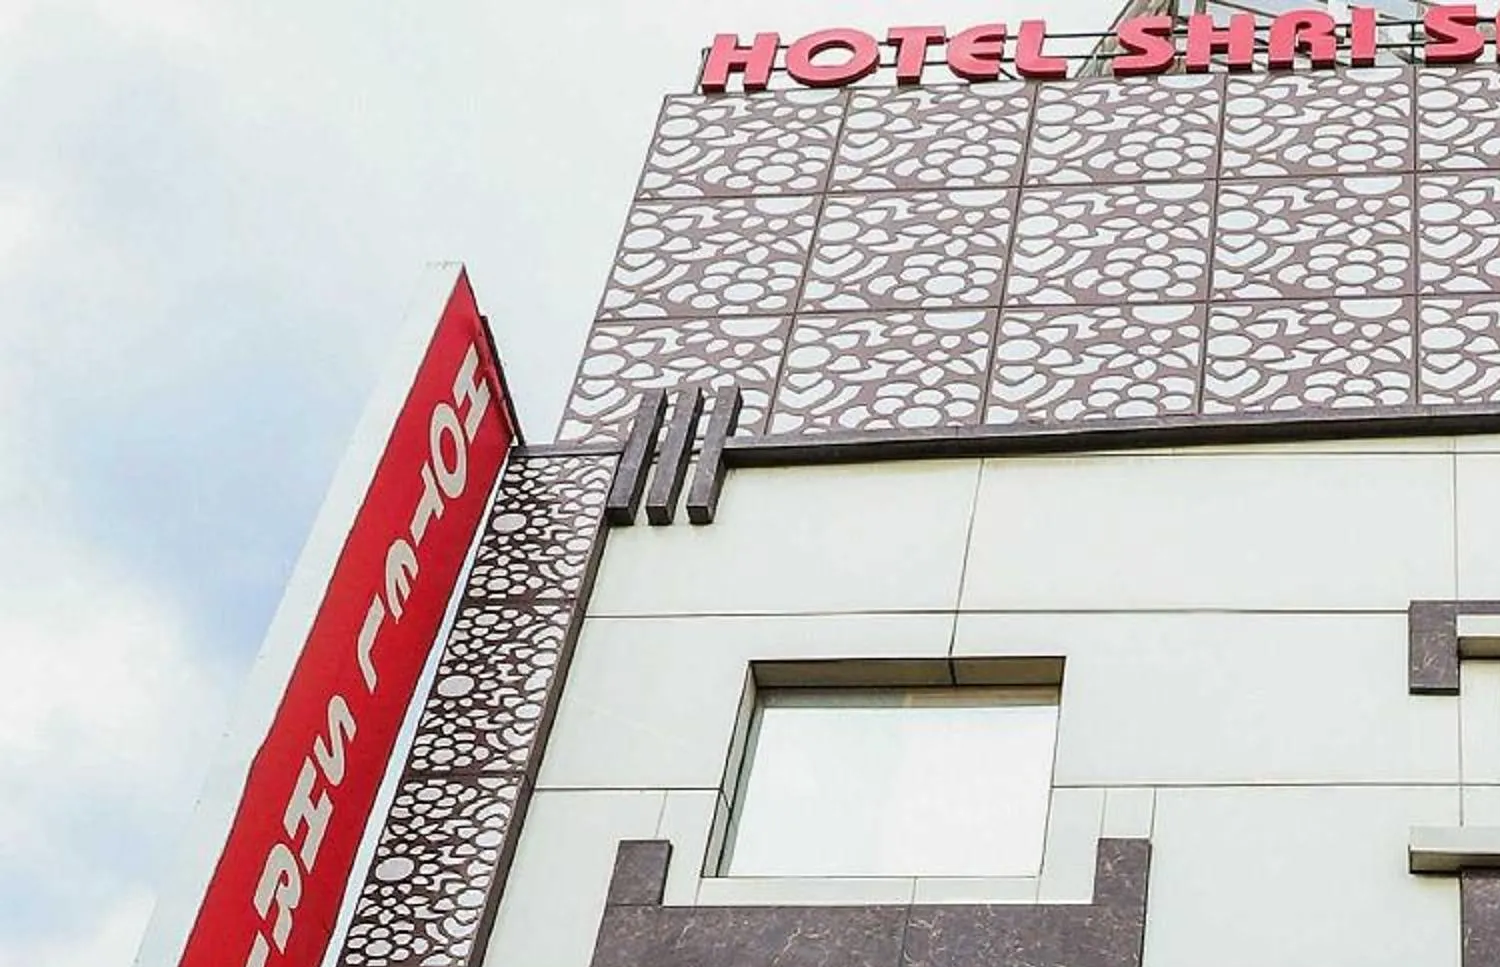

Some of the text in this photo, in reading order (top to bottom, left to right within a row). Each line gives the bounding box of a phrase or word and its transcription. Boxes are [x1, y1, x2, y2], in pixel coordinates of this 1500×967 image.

[700, 19, 1068, 94] HOTEL
[1113, 7, 1376, 77] SHRI
[356, 346, 491, 693] HOTEL
